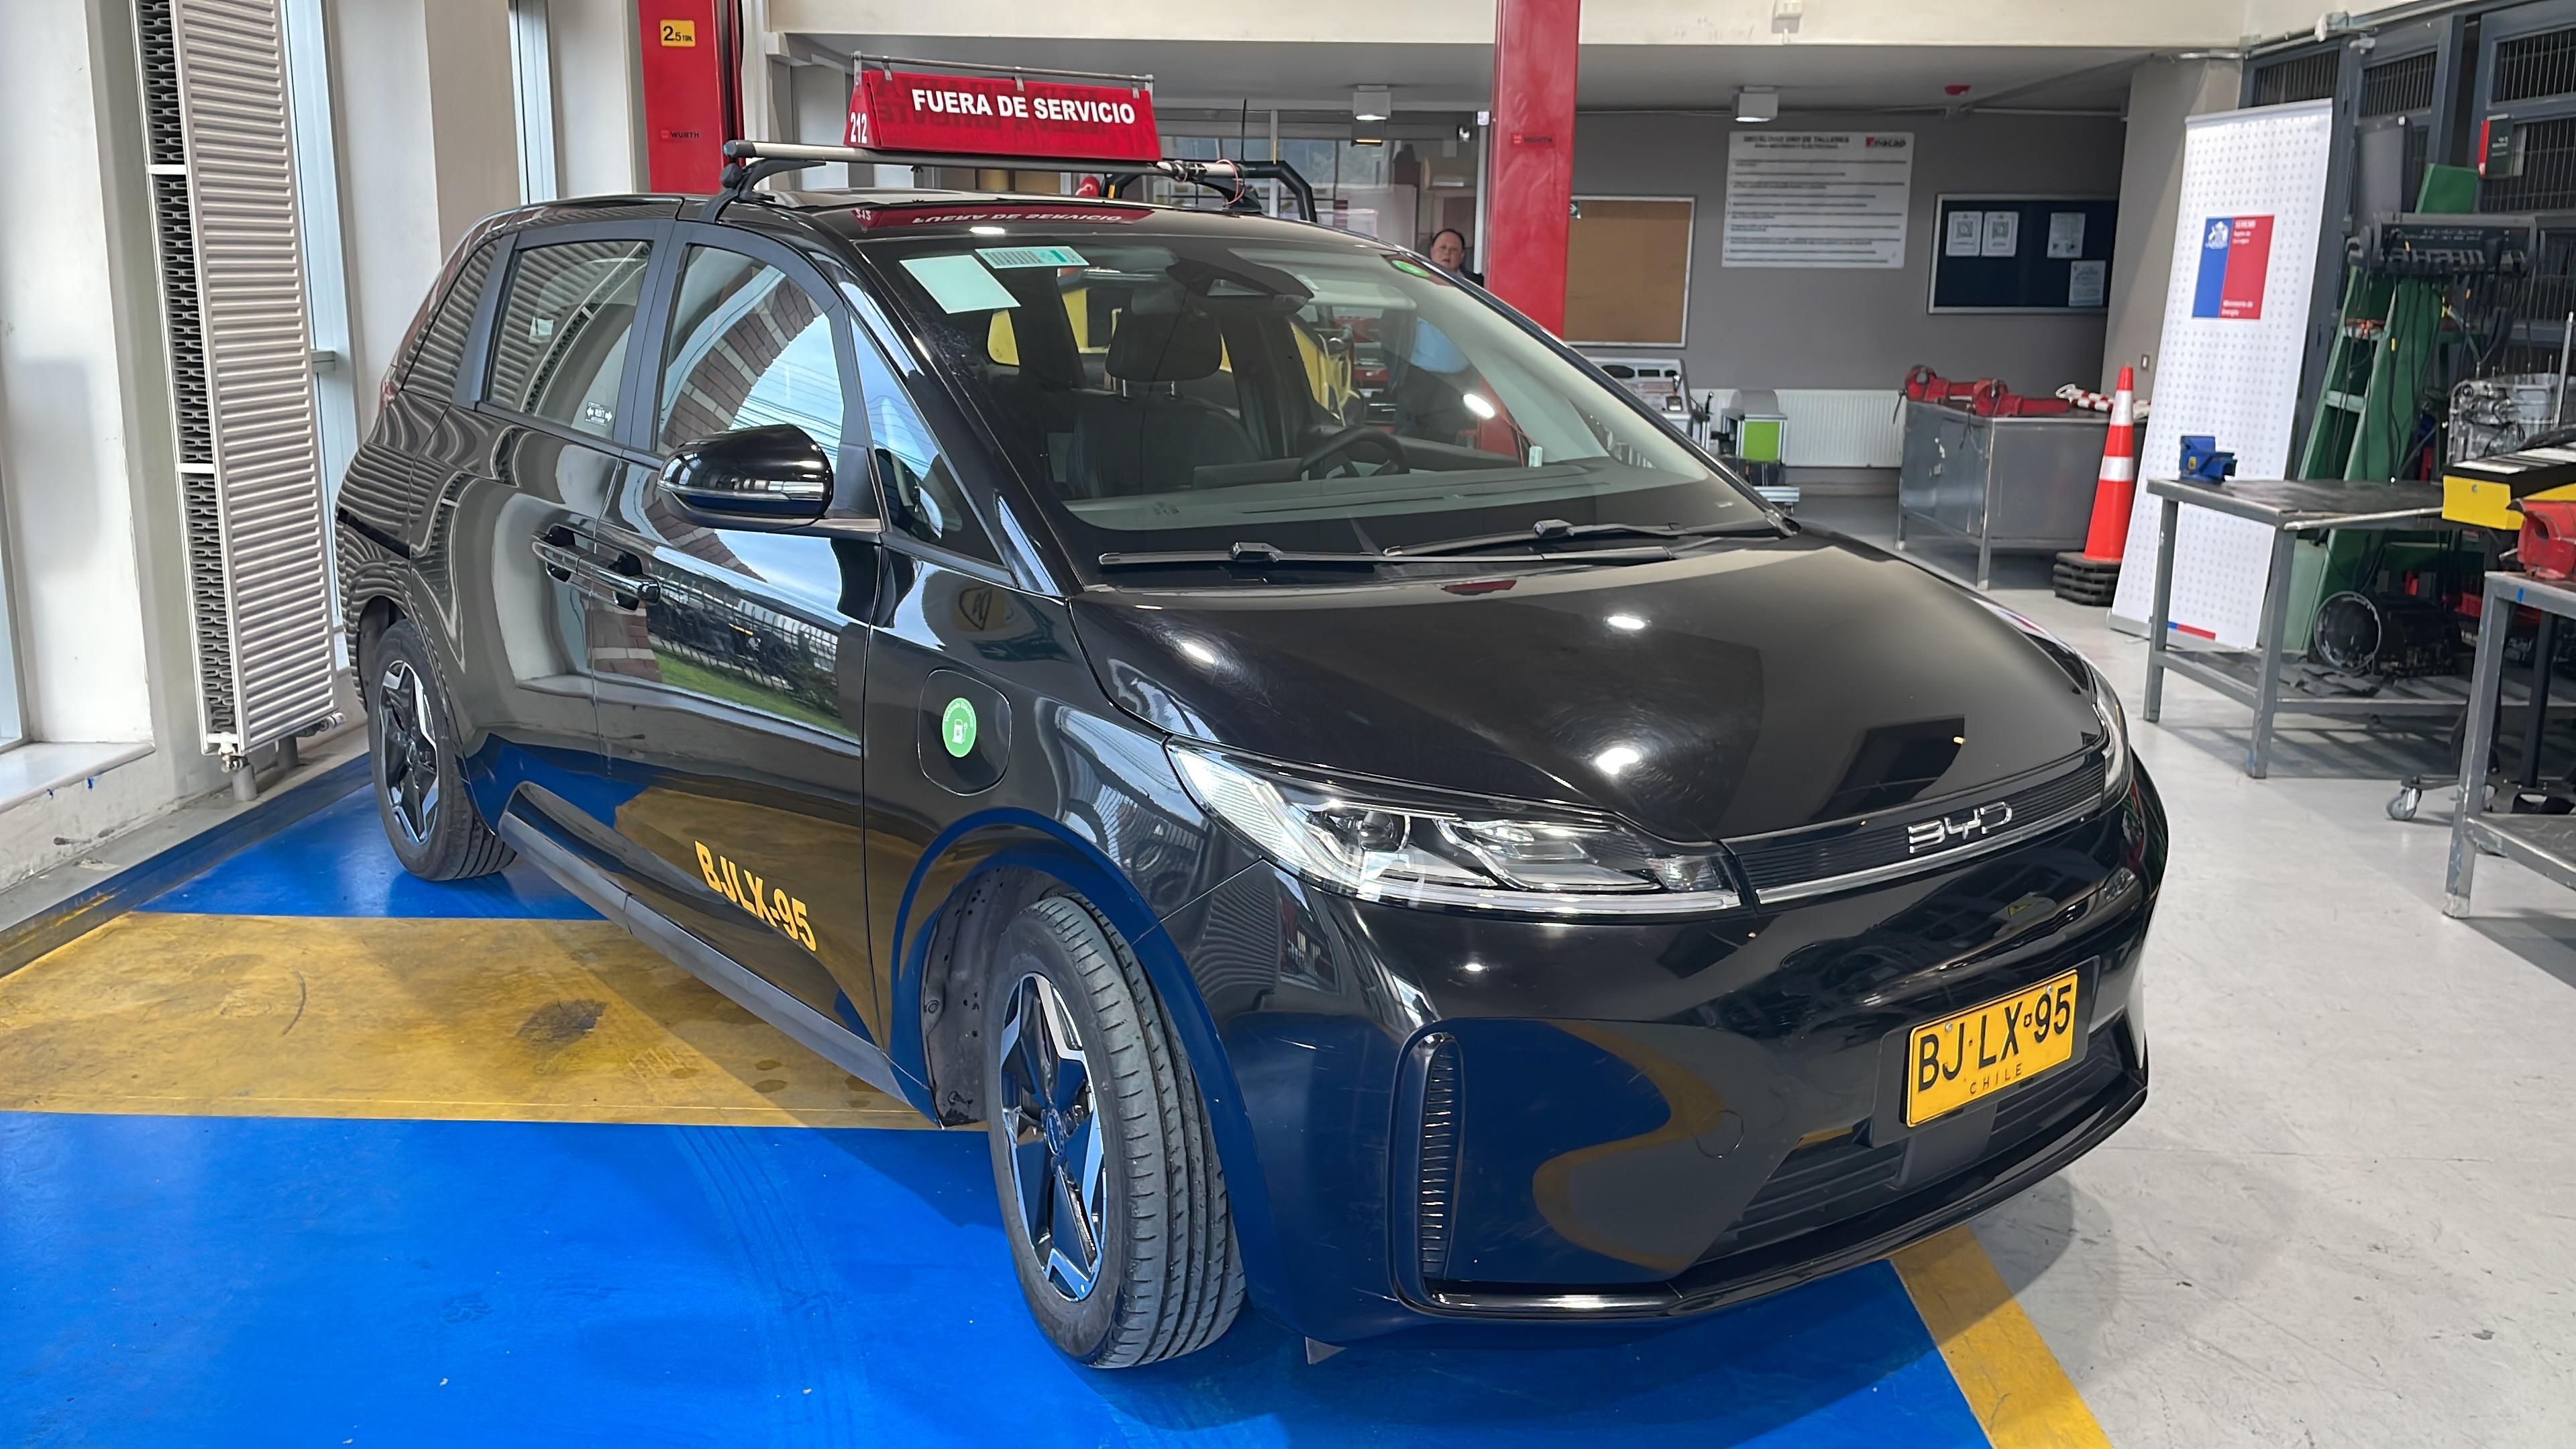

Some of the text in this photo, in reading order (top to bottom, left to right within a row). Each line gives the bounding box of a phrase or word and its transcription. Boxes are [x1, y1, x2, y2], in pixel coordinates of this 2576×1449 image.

[912, 89, 993, 116] FUERA
[997, 95, 1029, 118] DE
[1034, 97, 1135, 124] SERVICIO
[850, 112, 867, 144] 212
[1908, 801, 2012, 854] BYD
[695, 841, 816, 952] BJLX-95
[1969, 1063, 2023, 1095] CHILE
